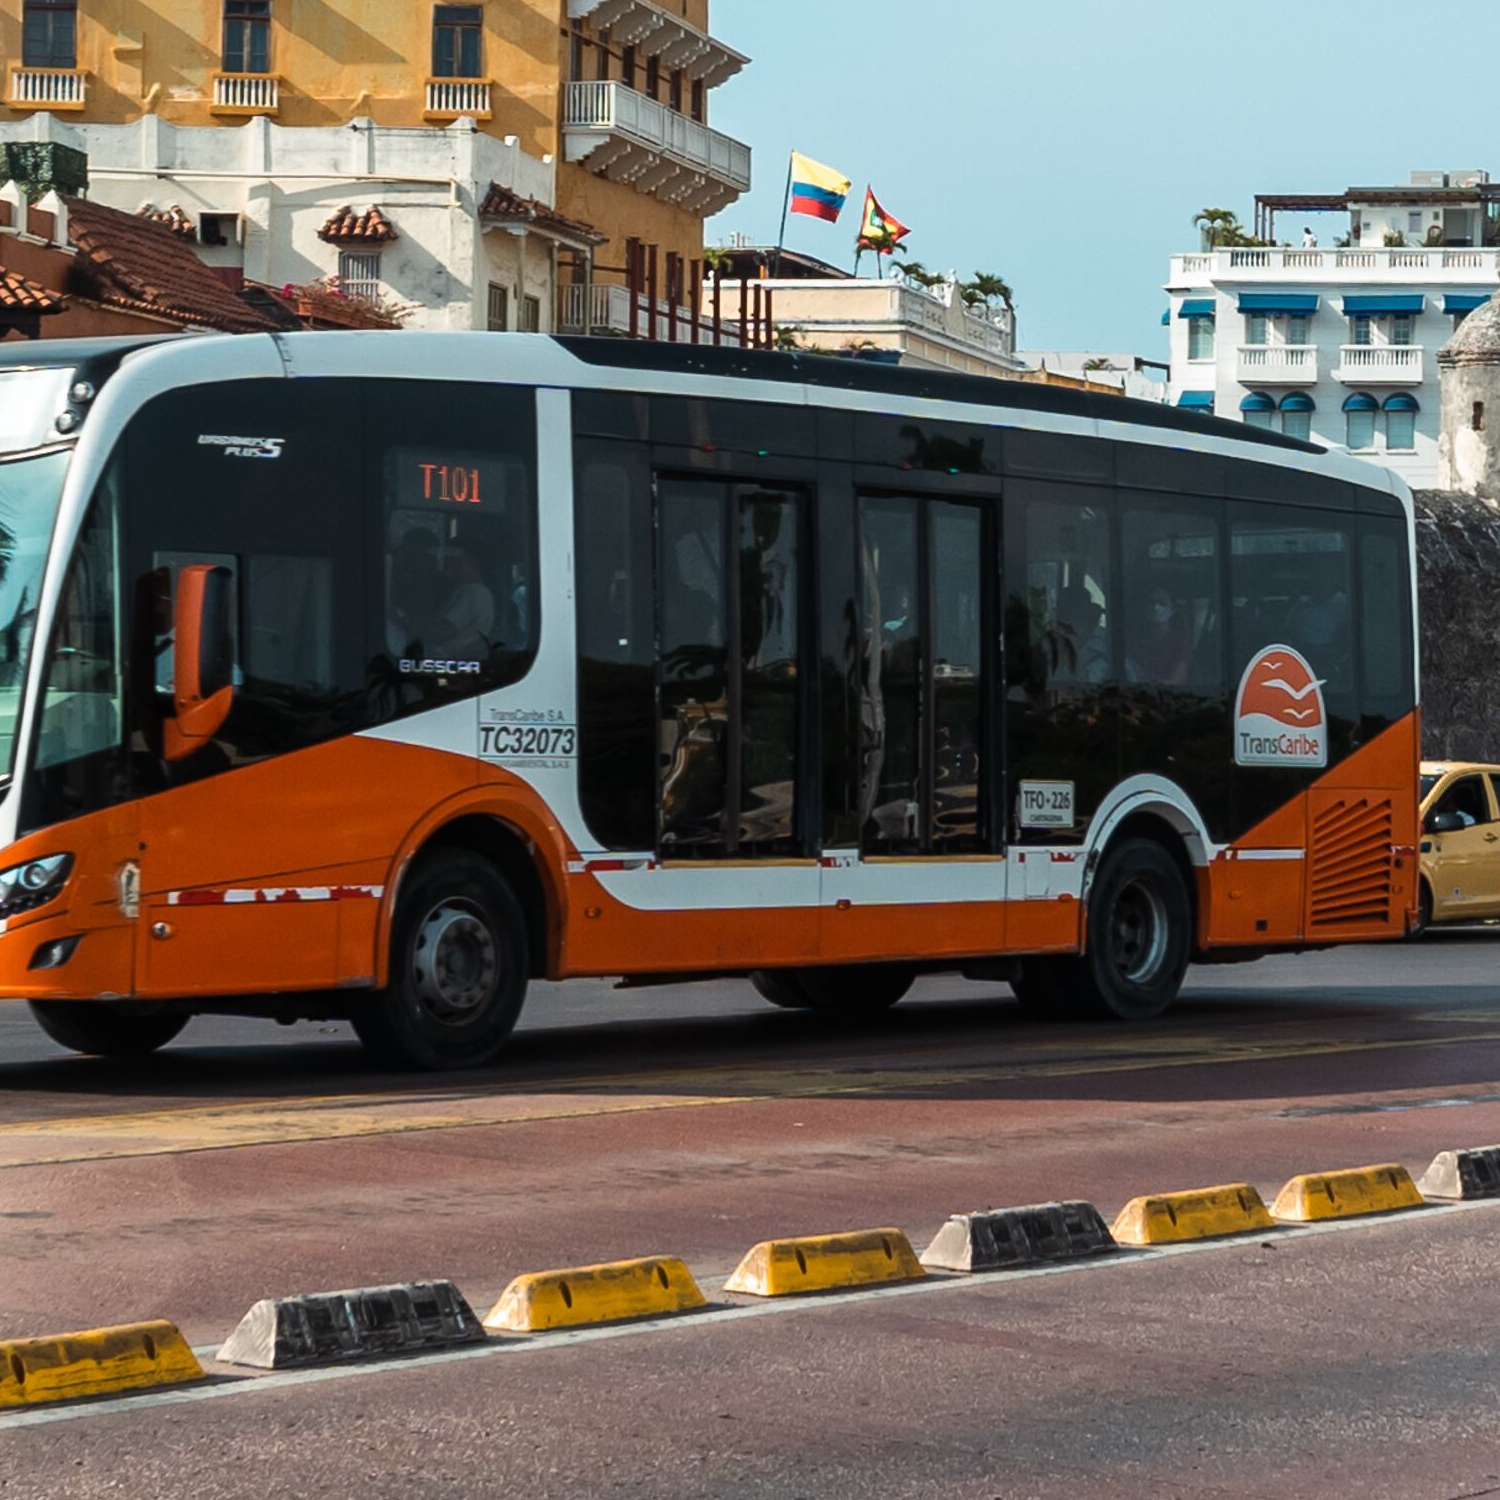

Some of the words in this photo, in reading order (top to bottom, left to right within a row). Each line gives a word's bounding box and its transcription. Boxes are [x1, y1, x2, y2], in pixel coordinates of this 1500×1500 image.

[419, 463, 481, 503] T101
[399, 659, 481, 674] BUSSCAR
[480, 726, 575, 754] TC32073
[1240, 732, 1319, 755] TransCaribe
